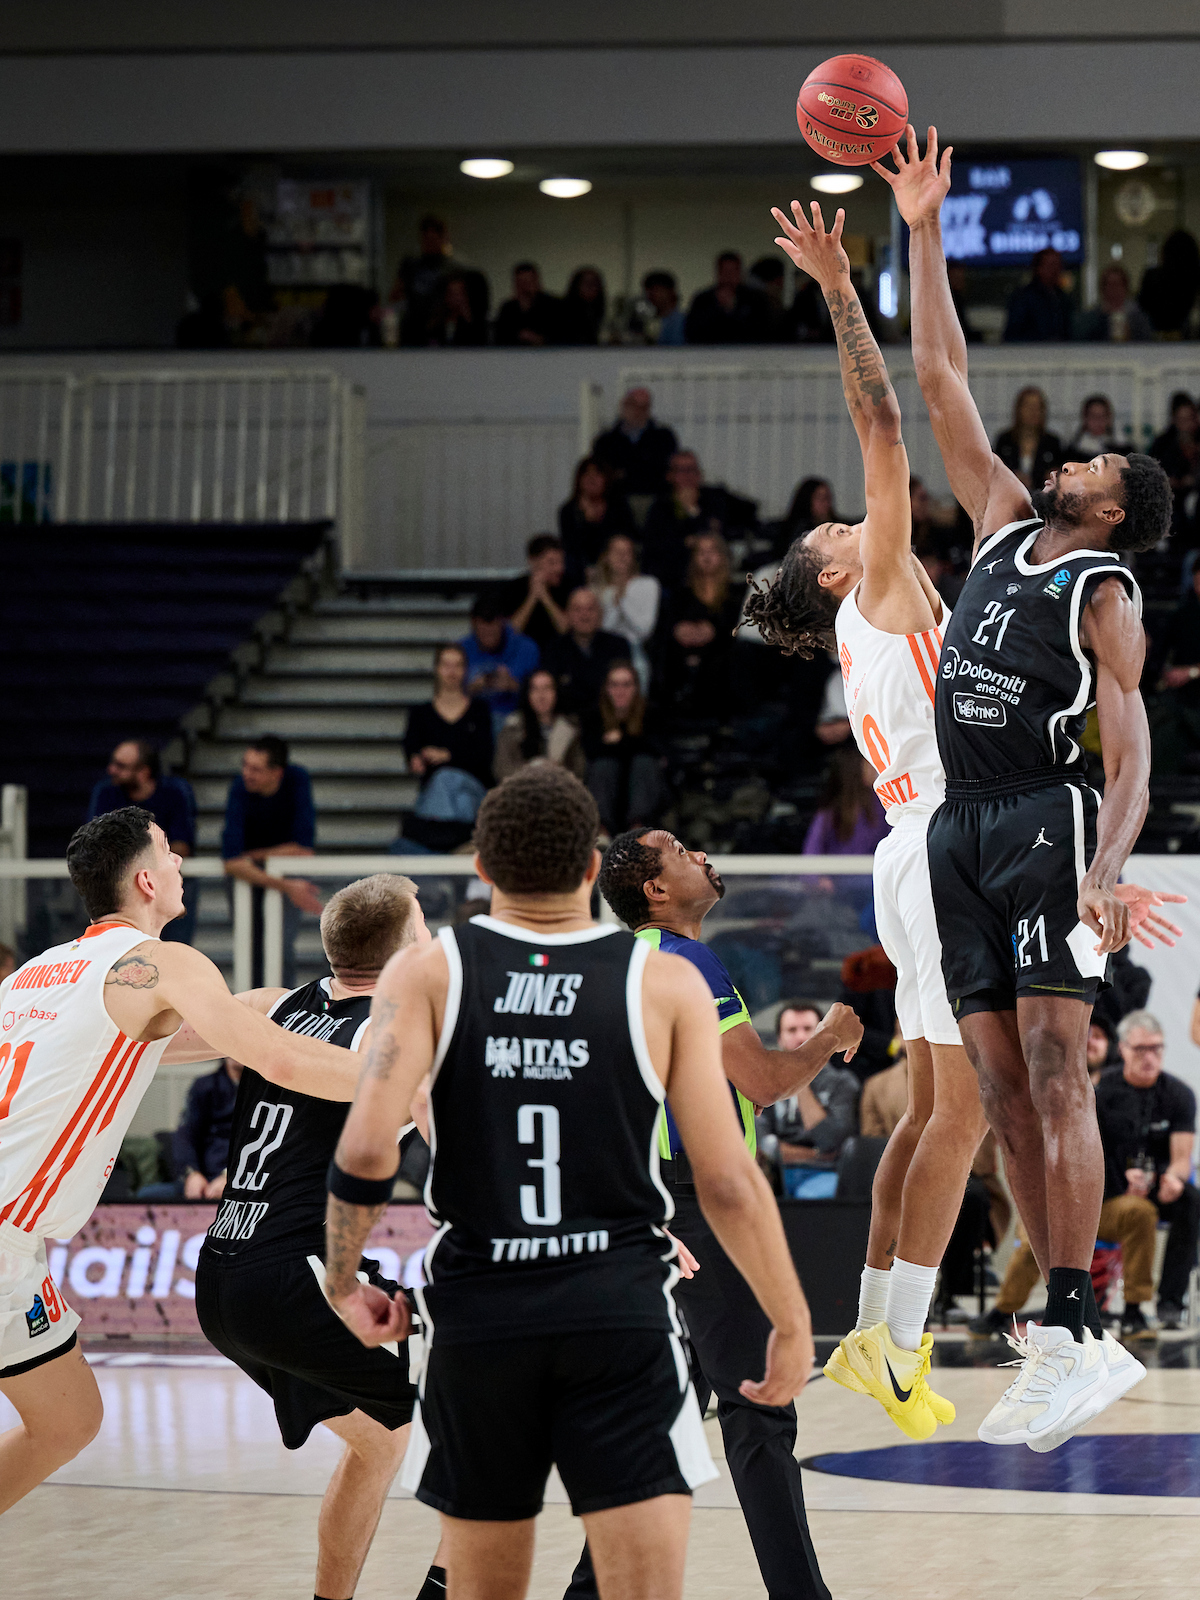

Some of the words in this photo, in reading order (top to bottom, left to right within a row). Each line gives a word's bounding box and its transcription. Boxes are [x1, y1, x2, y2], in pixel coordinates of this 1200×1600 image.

[818, 92, 856, 112] EuroCup
[805, 121, 875, 154] SPALDING
[972, 600, 1016, 651] 21
[958, 659, 1027, 694] Dolomiti
[975, 682, 1021, 705] energia
[956, 701, 1000, 720] TRENTINO
[1018, 915, 1049, 968] 21
[11, 959, 92, 990] MINCHEV
[493, 971, 584, 1016] JONES
[523, 1038, 590, 1067] ITAS
[523, 1066, 573, 1080] MUTUA
[232, 1101, 294, 1191] 22
[517, 1104, 562, 1226] 3
[207, 1199, 270, 1240] TRENTO
